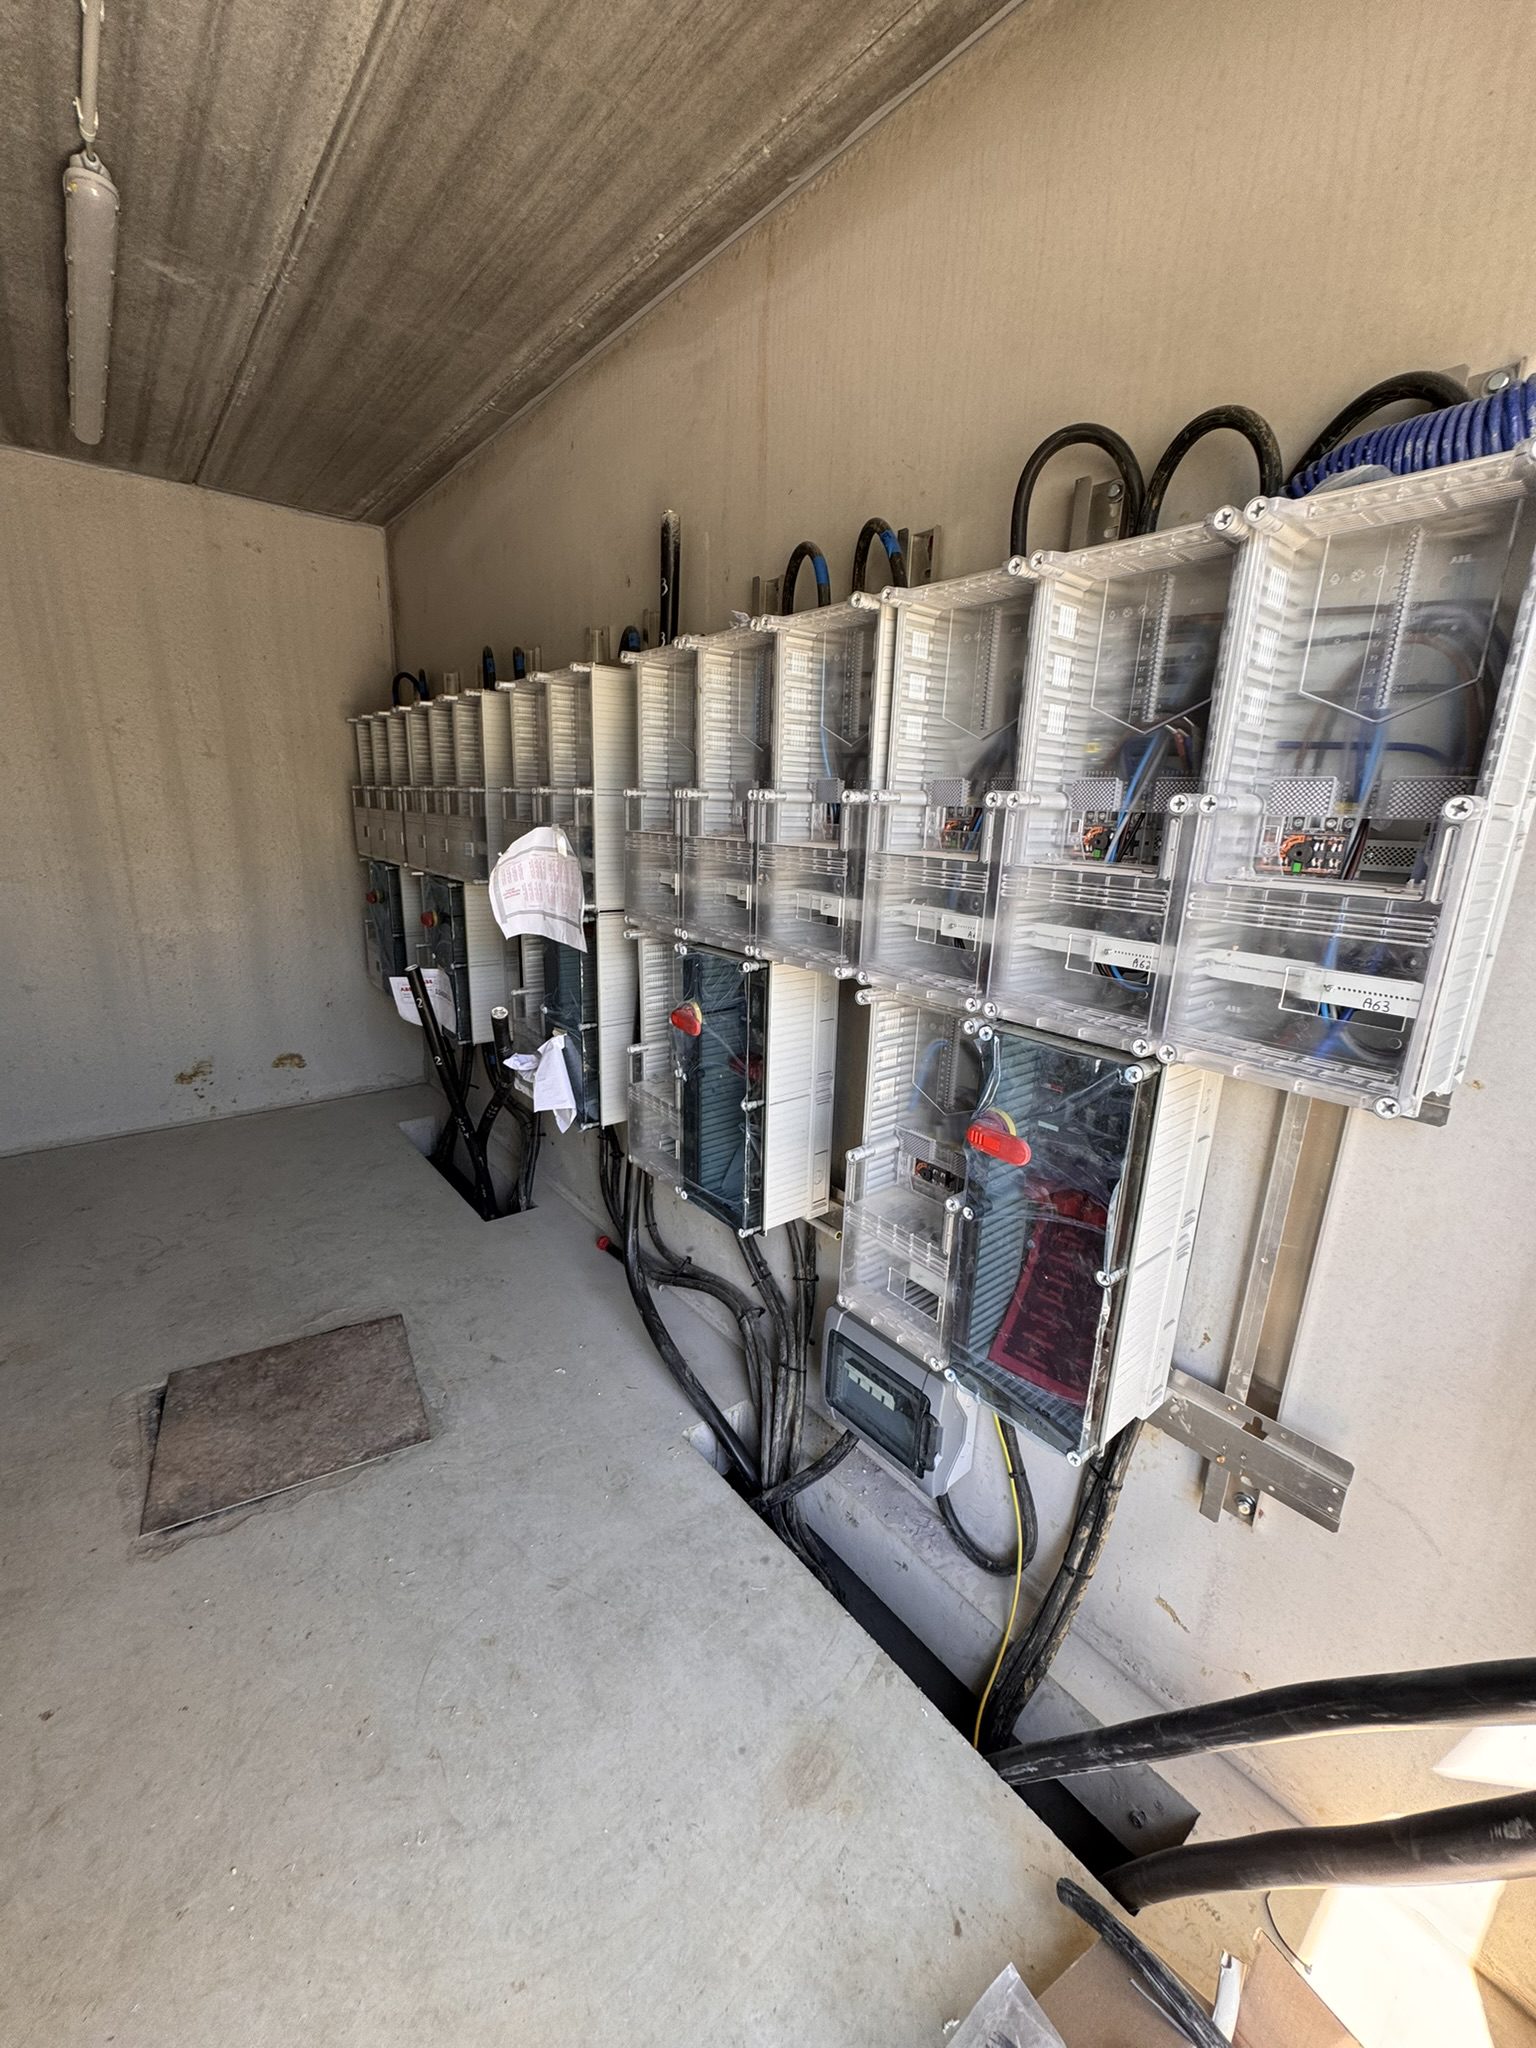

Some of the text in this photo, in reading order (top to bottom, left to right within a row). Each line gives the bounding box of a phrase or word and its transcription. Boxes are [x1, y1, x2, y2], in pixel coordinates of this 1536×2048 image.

[661, 577, 668, 596] 3
[1132, 958, 1151, 970] A62
[416, 998, 423, 1008] 2
[1362, 997, 1390, 1013] A63
[434, 1056, 443, 1066] 2
